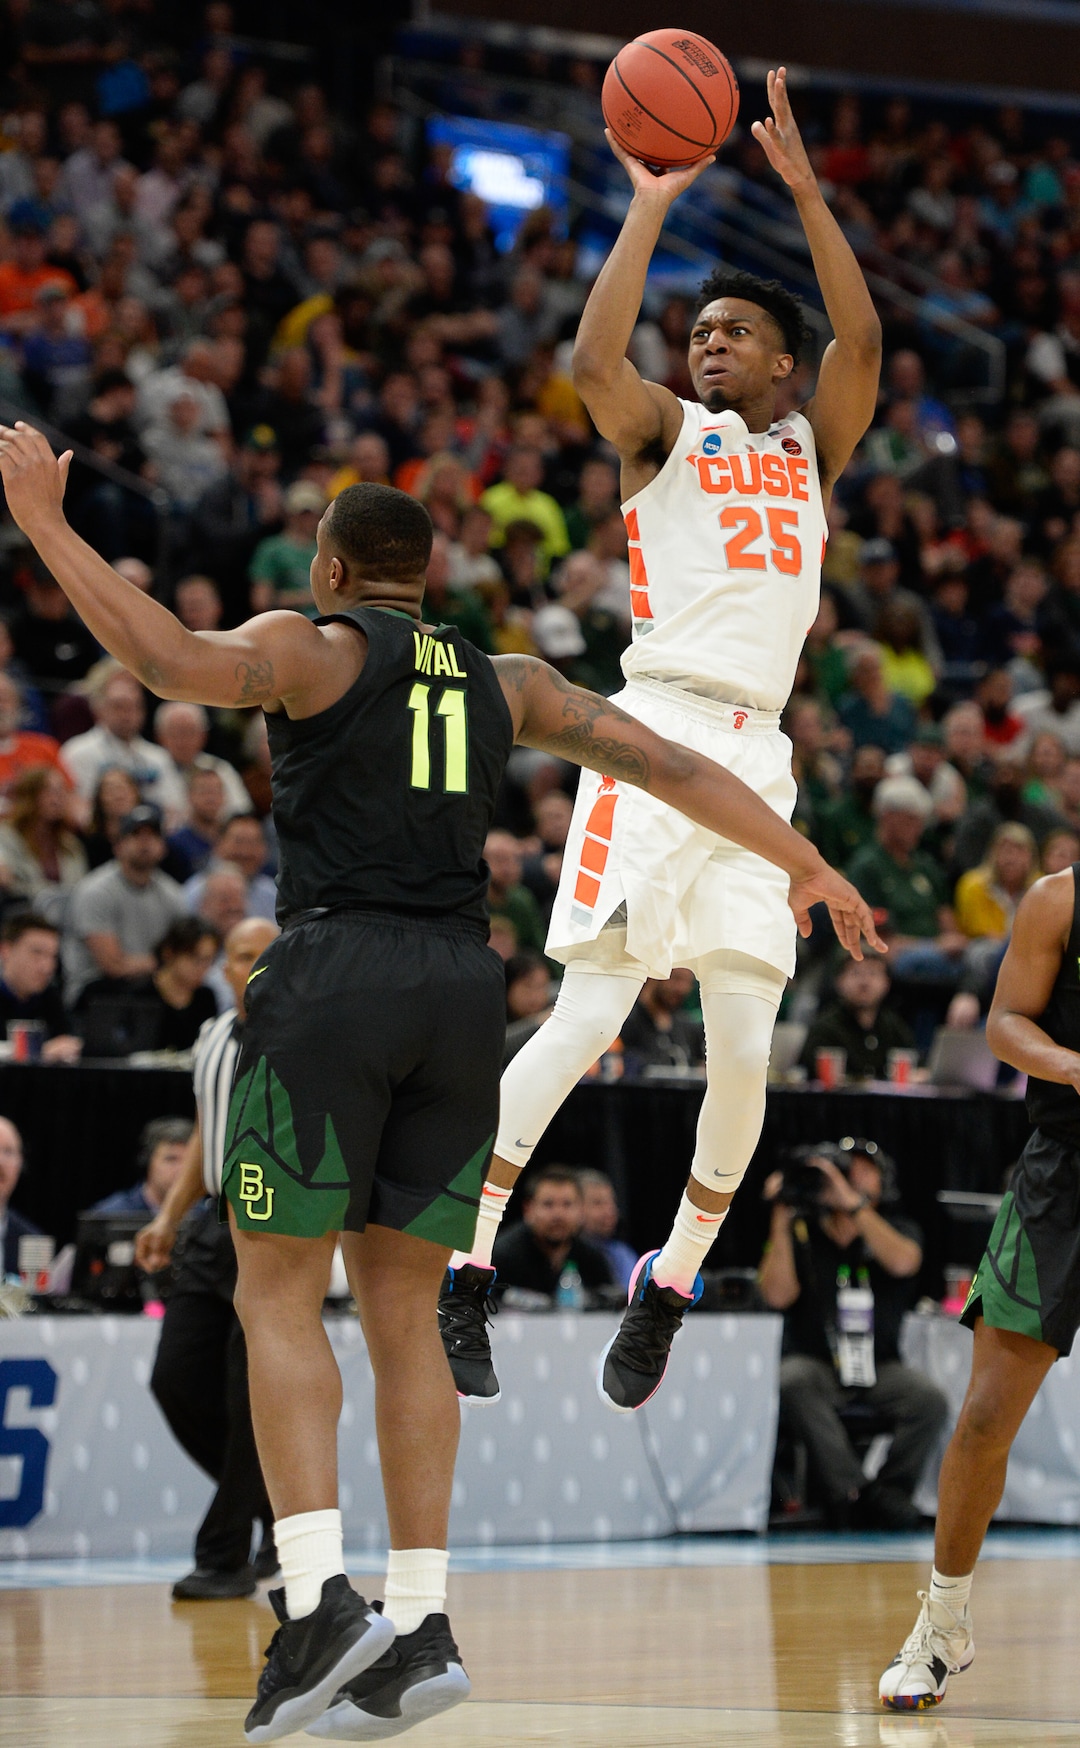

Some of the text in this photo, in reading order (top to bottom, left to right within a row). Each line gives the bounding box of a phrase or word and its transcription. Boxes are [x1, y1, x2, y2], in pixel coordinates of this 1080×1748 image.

[719, 506, 803, 578] 25
[413, 631, 468, 679] VITAL
[406, 681, 468, 794] 11
[239, 1162, 275, 1221] BU
